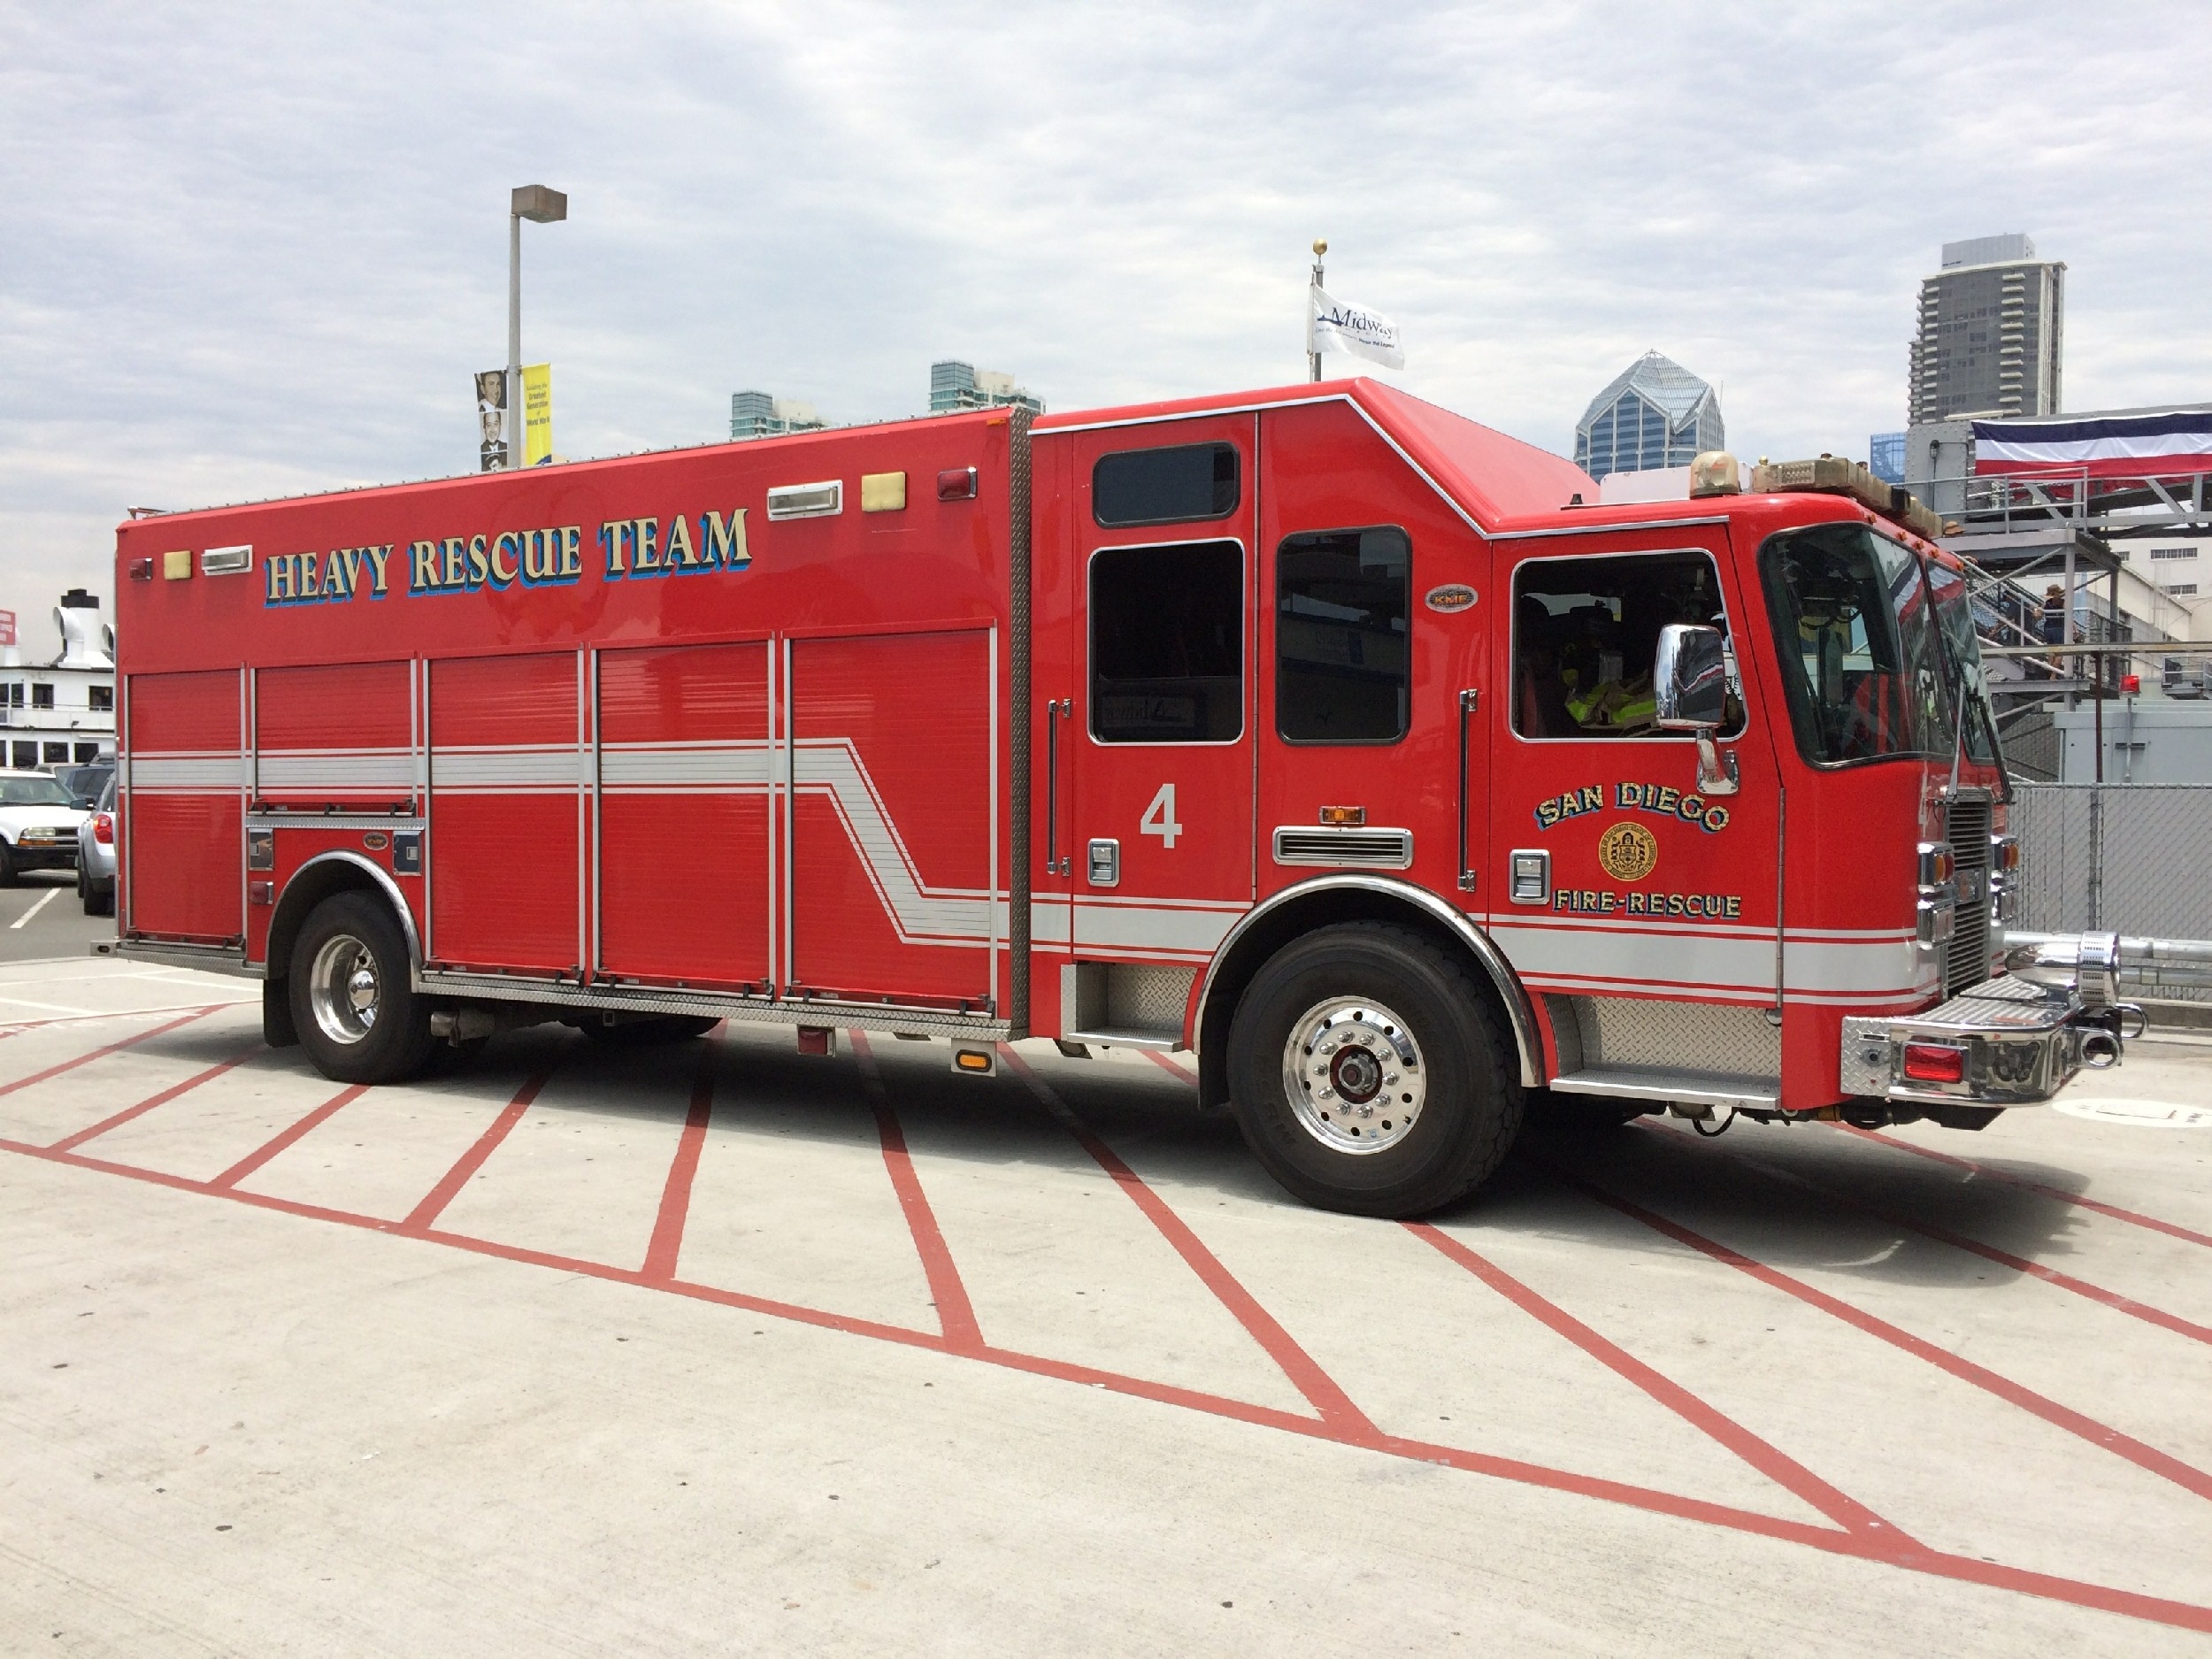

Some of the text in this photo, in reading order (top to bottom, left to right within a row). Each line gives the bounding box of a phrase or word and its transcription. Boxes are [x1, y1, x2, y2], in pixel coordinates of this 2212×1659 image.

[1332, 307, 1392, 339] Midway
[265, 507, 752, 608] HEAVY RESCUE TEAM
[1140, 783, 1183, 849] 4
[1533, 782, 1731, 833] SAN DIEGO
[1552, 888, 1741, 920] FIRE-RESCUE
